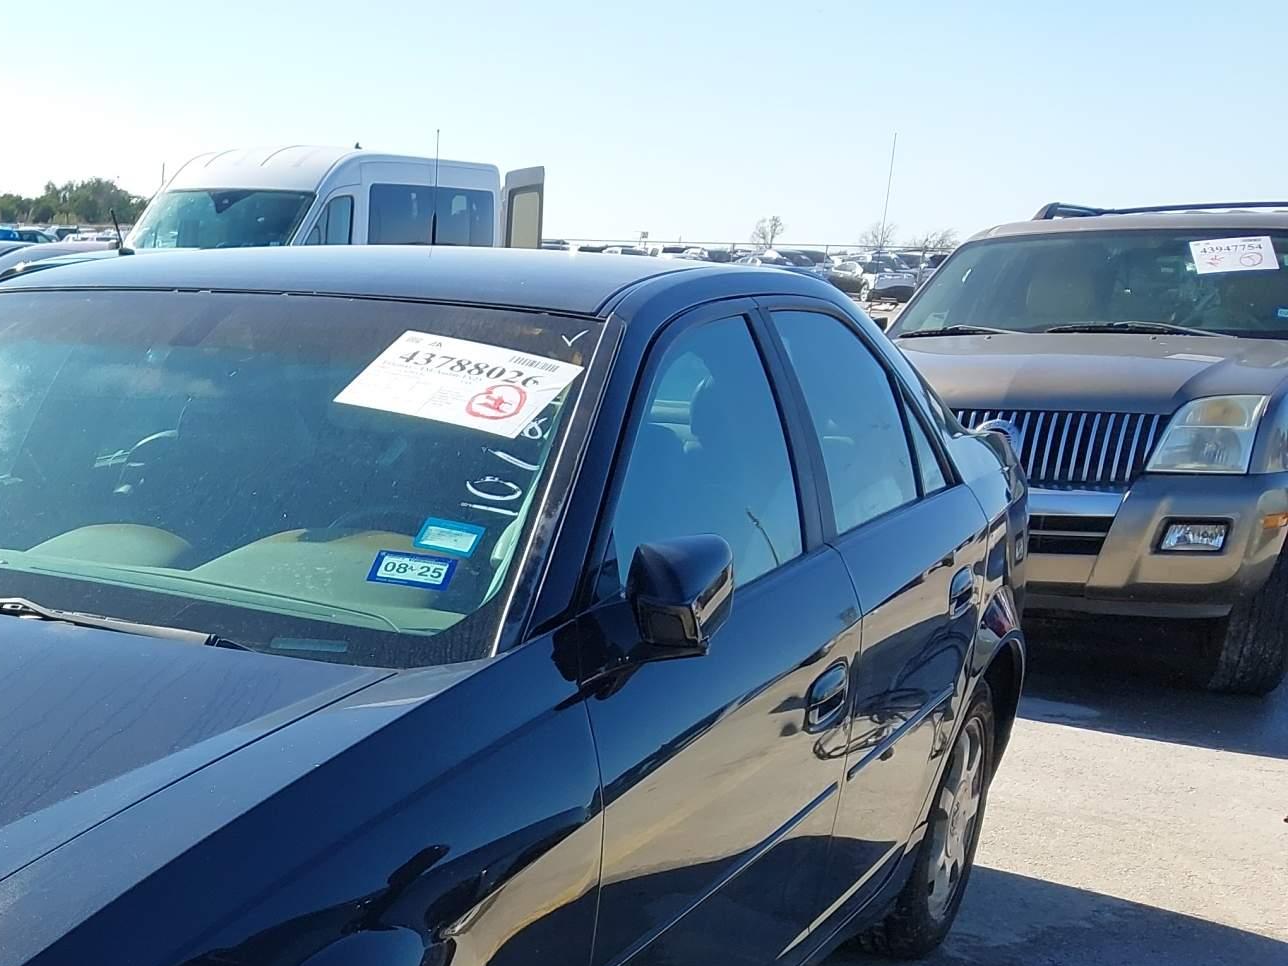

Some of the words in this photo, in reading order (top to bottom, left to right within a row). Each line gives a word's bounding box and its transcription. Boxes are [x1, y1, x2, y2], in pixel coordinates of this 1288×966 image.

[399, 350, 545, 387] 43788026
[383, 561, 410, 575] 08
[416, 565, 445, 579] 25
